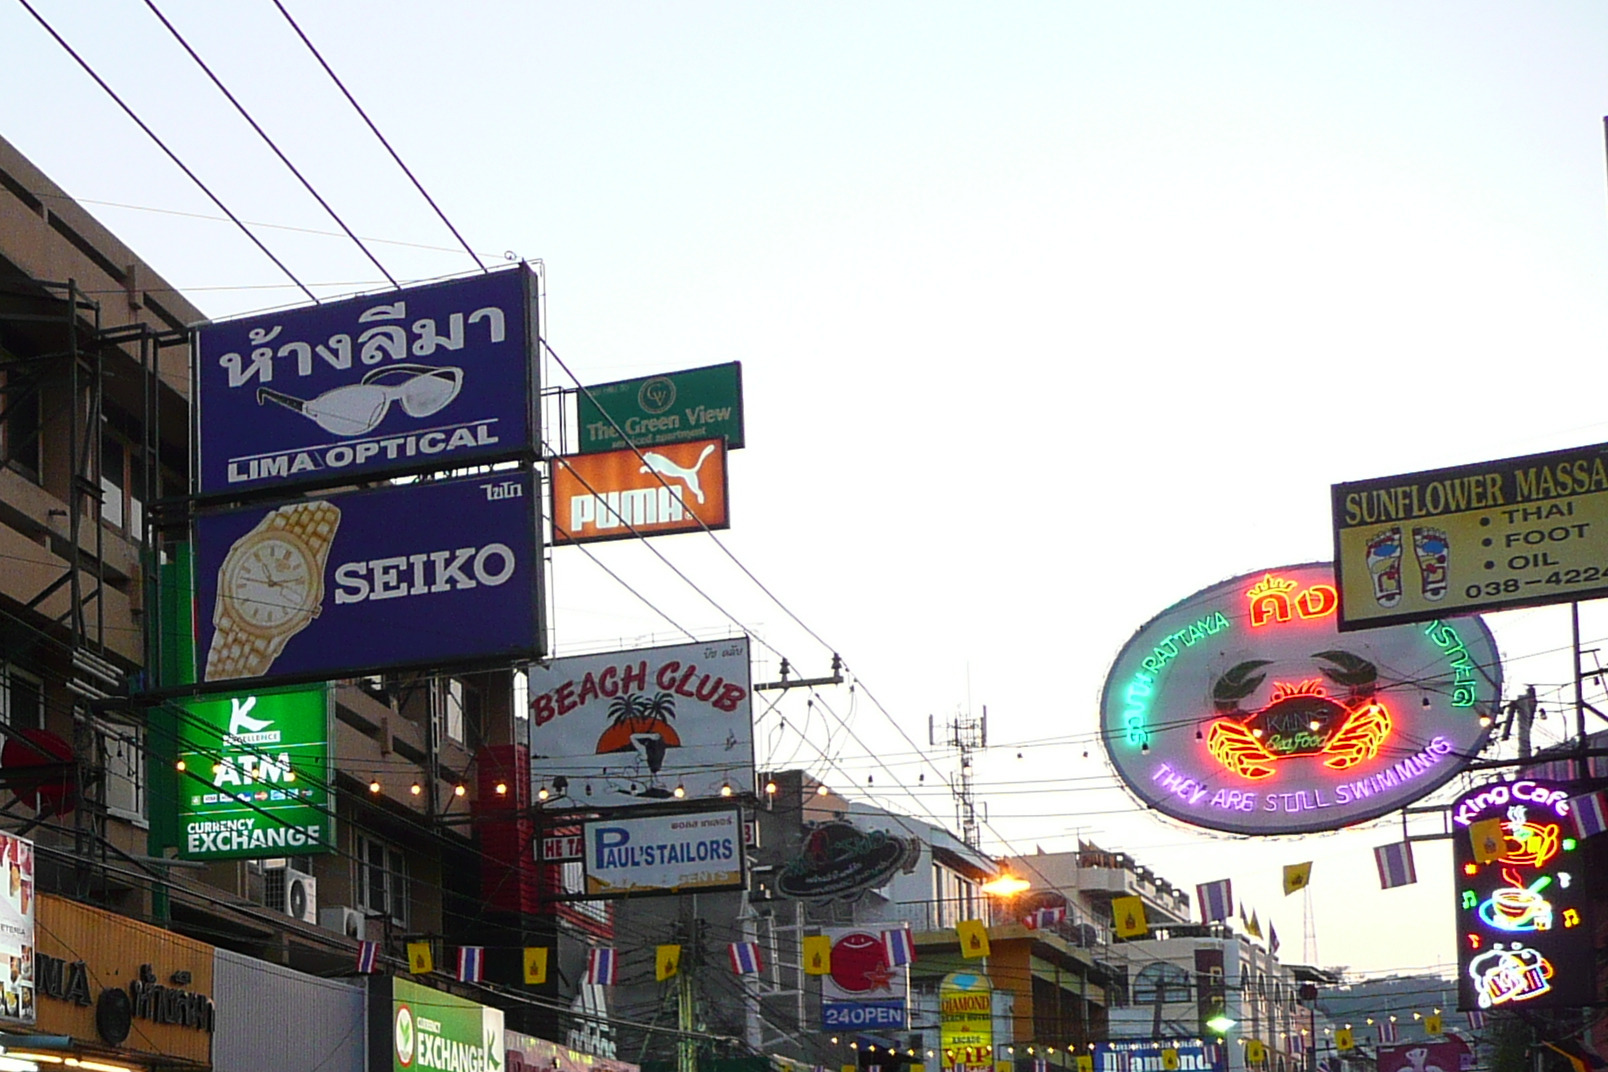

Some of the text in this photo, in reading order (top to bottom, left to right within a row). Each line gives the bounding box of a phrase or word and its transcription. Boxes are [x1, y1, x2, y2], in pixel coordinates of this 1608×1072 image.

[219, 301, 506, 388] ห้างลีมา
[587, 406, 732, 442] The Green View
[228, 424, 499, 484] LIMA OPTICAL
[570, 485, 684, 532] PUMA
[1345, 472, 1504, 525] SUNFLOWER
[1502, 501, 1574, 525] THAI
[1505, 523, 1590, 548] FOOT
[334, 543, 516, 605] SEIKO
[1508, 552, 1559, 571] OIL
[531, 660, 747, 727] BEACH CLUB
[1124, 673, 1157, 745] SOUTH
[229, 697, 275, 735] K
[213, 752, 292, 788] ATM
[1152, 763, 1207, 806] THEY
[1208, 788, 1256, 813] ARE
[1453, 786, 1511, 827] King
[187, 817, 255, 834] CURRENCY
[188, 825, 320, 853] EXCHANGE
[658, 838, 733, 866] TAILORS
[943, 996, 990, 1013] DIAMOND
[943, 1047, 992, 1067] VIP
